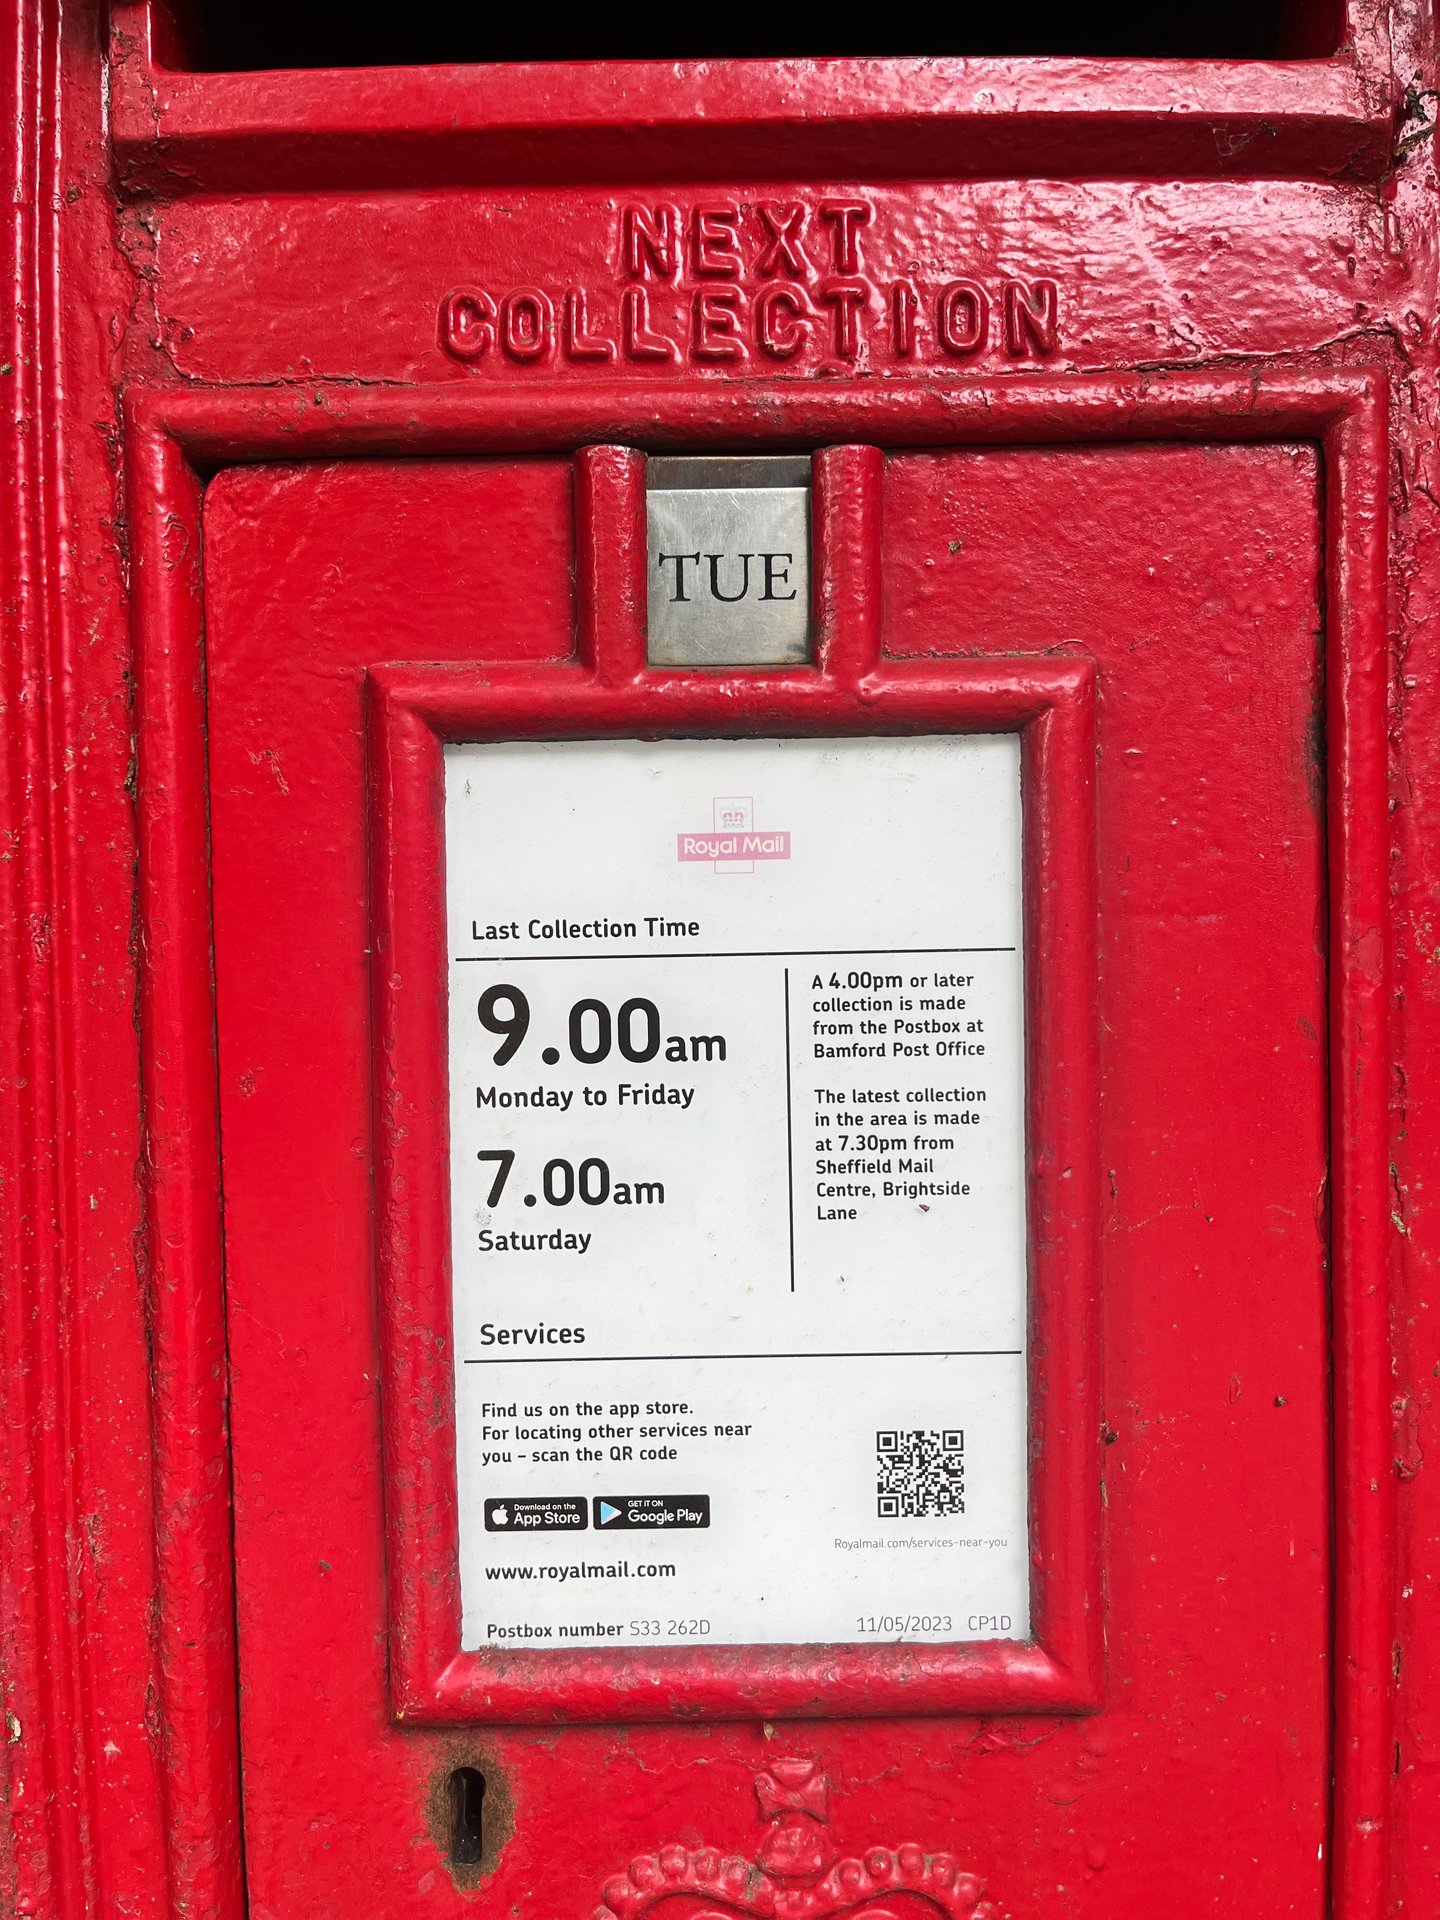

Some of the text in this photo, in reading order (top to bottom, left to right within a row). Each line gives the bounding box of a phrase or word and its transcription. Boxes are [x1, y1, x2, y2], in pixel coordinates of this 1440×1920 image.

[620, 200, 875, 281] NEXT
[437, 277, 1068, 362] COLLECTION
[658, 551, 797, 603] TUE
[684, 836, 784, 857] Royal Mail
[472, 916, 700, 941] Last Collection Time
[811, 971, 975, 993] A 4.00pm or later
[812, 995, 966, 1013] collection is made
[477, 983, 727, 1067] 9.00am
[812, 1018, 984, 1036] from the Postbox at
[814, 1040, 985, 1059] Bamford Post Office
[476, 1082, 695, 1112] Monday to Friday
[813, 1086, 987, 1104] The latest collection
[815, 1109, 980, 1127] in the area is made
[815, 1134, 954, 1155] at 7.30pm from
[815, 1157, 934, 1175] Sheffield Mail
[476, 1149, 665, 1209] 7.00am
[816, 1180, 971, 1200] Centre, Brightside
[817, 1205, 858, 1221] Lane
[478, 1228, 592, 1255] Saturday
[480, 1322, 586, 1346] Services
[482, 1401, 694, 1419] Find us on the app store.
[482, 1422, 753, 1443] For locating other services near
[481, 1452, 512, 1467] you
[532, 1450, 570, 1463] scan
[575, 1446, 603, 1462] the
[609, 1445, 633, 1462] QR
[639, 1445, 678, 1461] code
[628, 1500, 642, 1508] GET
[513, 1512, 581, 1526] App Store
[628, 1508, 703, 1524] Google Play
[834, 1537, 1008, 1551] Royalmail.com/services-near-you
[485, 1560, 676, 1583] www.royalmail.com
[487, 1619, 711, 1639] Postbox number S33 262D
[856, 1615, 1012, 1633] 11/05/2023 CP1D
